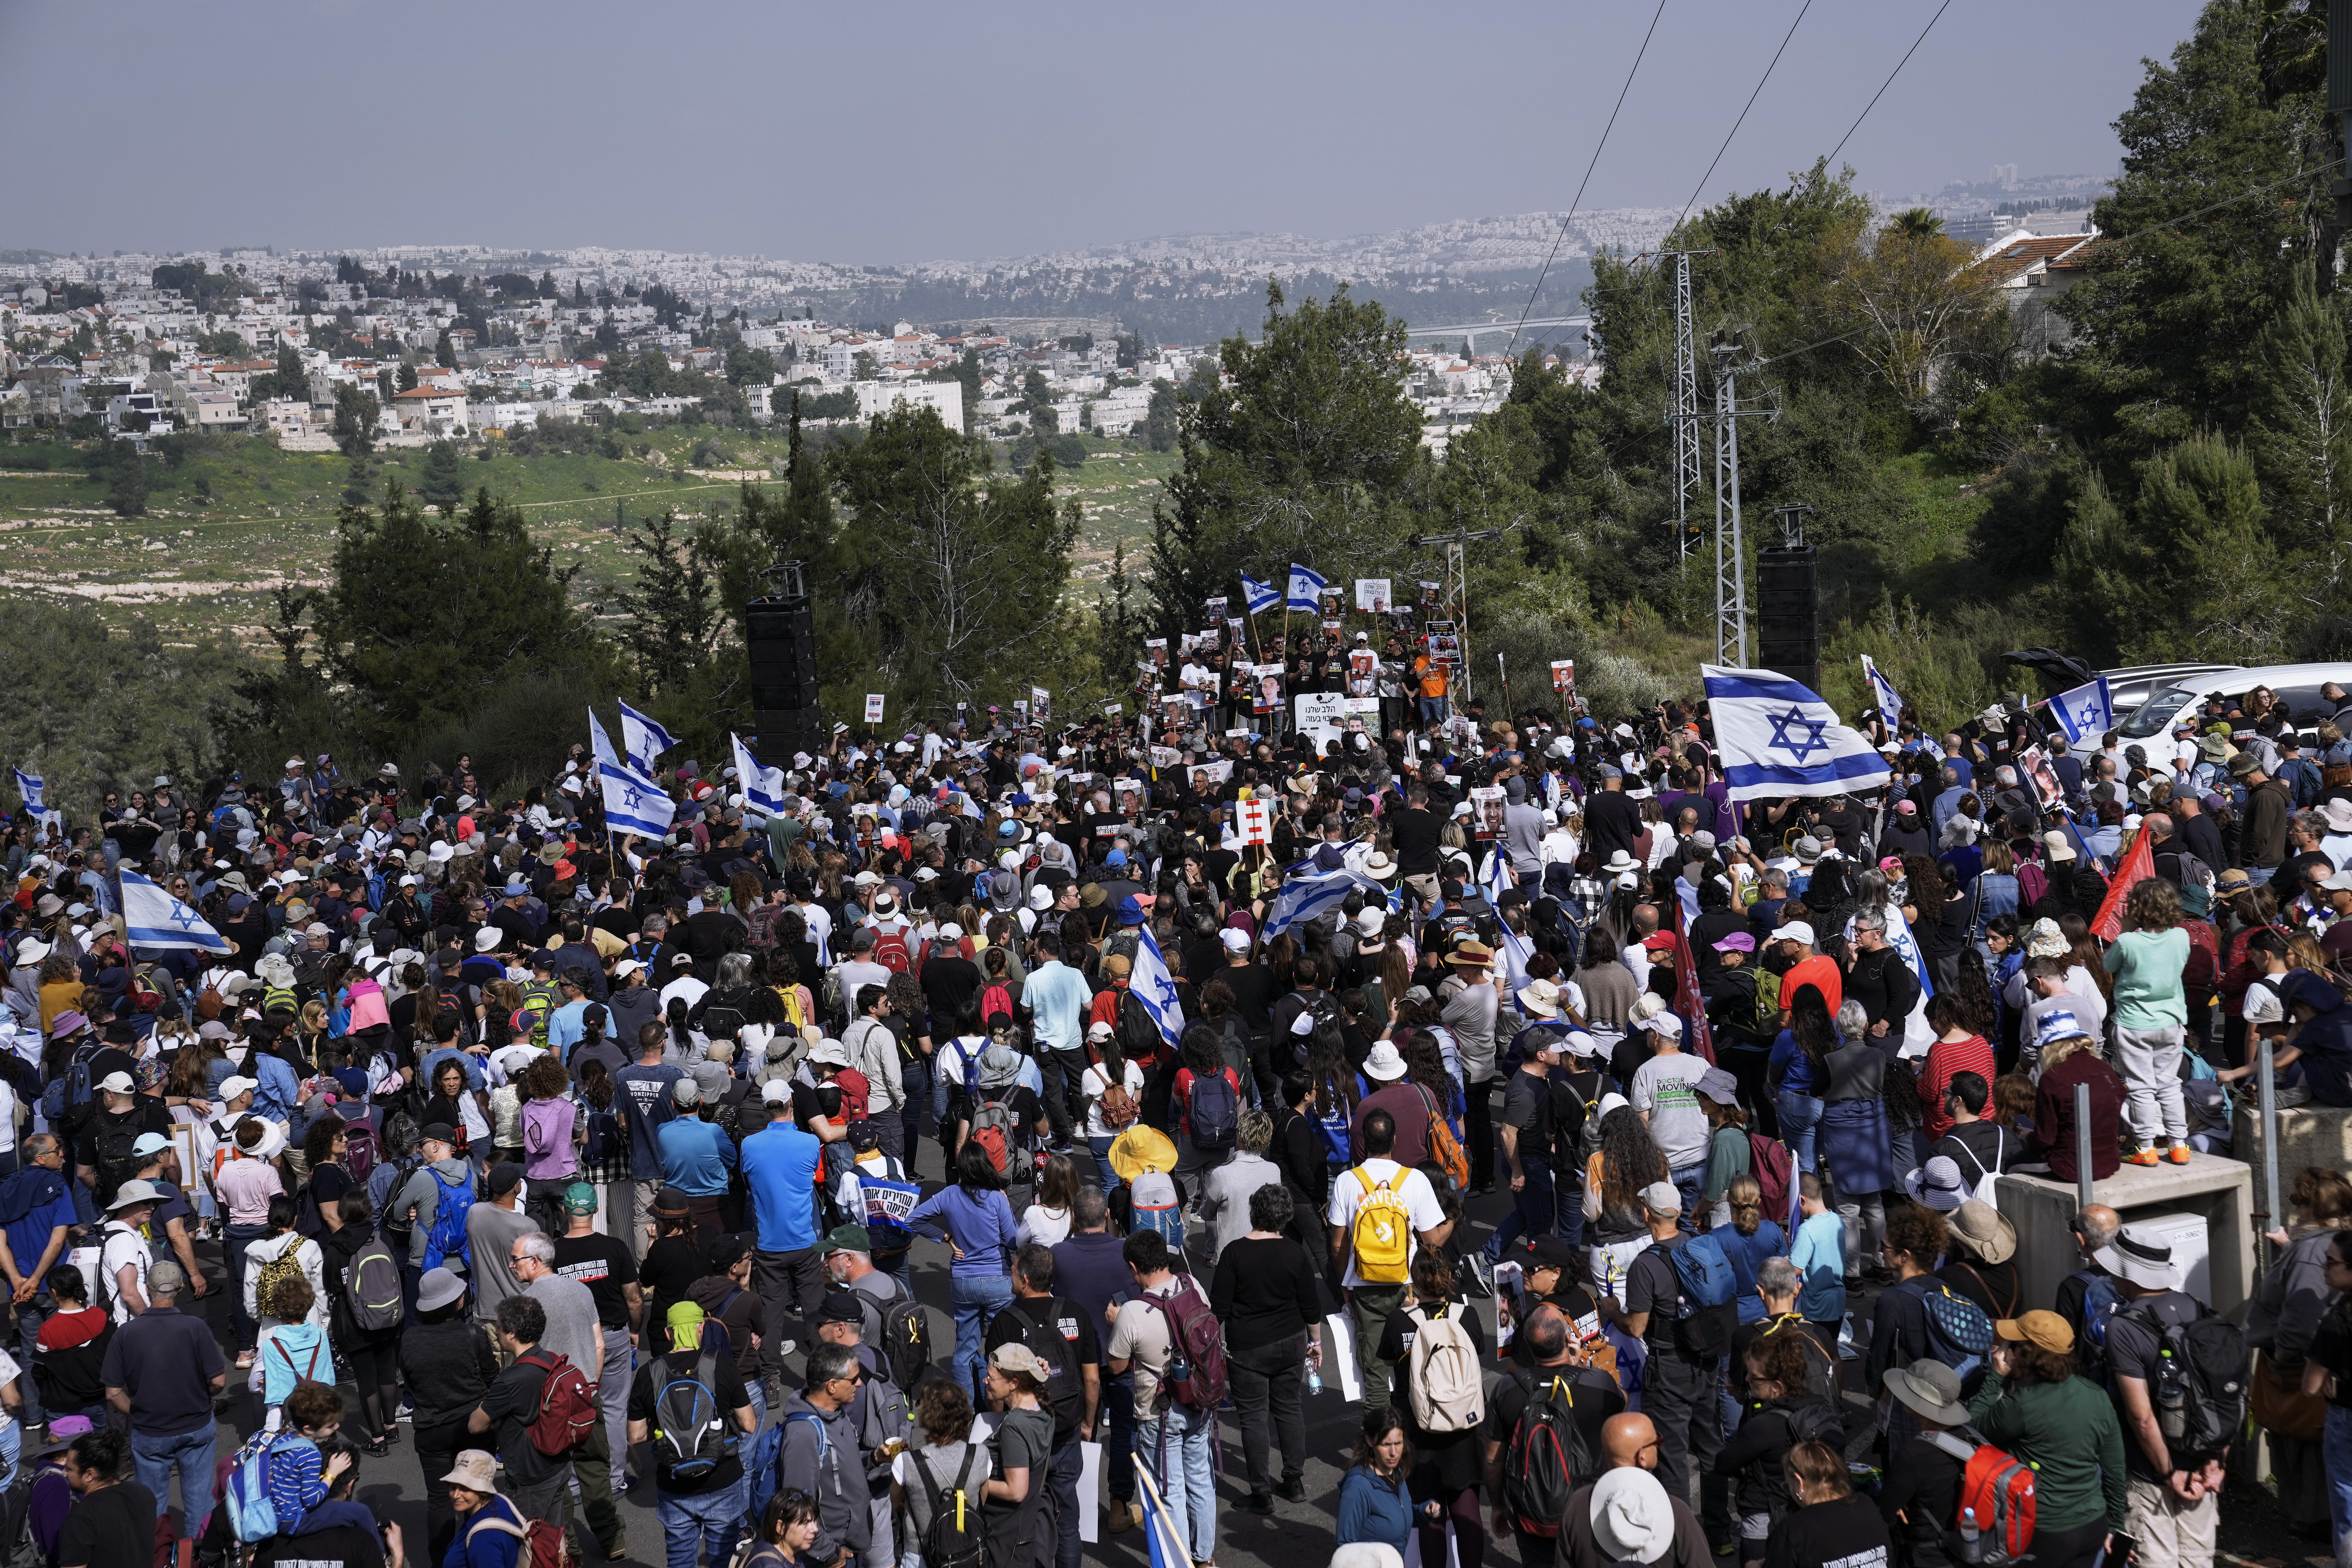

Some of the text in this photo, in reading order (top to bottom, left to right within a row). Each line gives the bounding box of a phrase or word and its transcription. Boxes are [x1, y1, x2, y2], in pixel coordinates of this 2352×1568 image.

[864, 1189, 913, 1207] מחזירים אותם
[866, 1200, 885, 1212] עכשיו!
[886, 1201, 909, 1218] הביתה
[557, 1259, 607, 1276] מטה המשפחות להחזרת
[585, 1267, 609, 1279] החטופים
[1064, 1318, 1077, 1326] מטה
